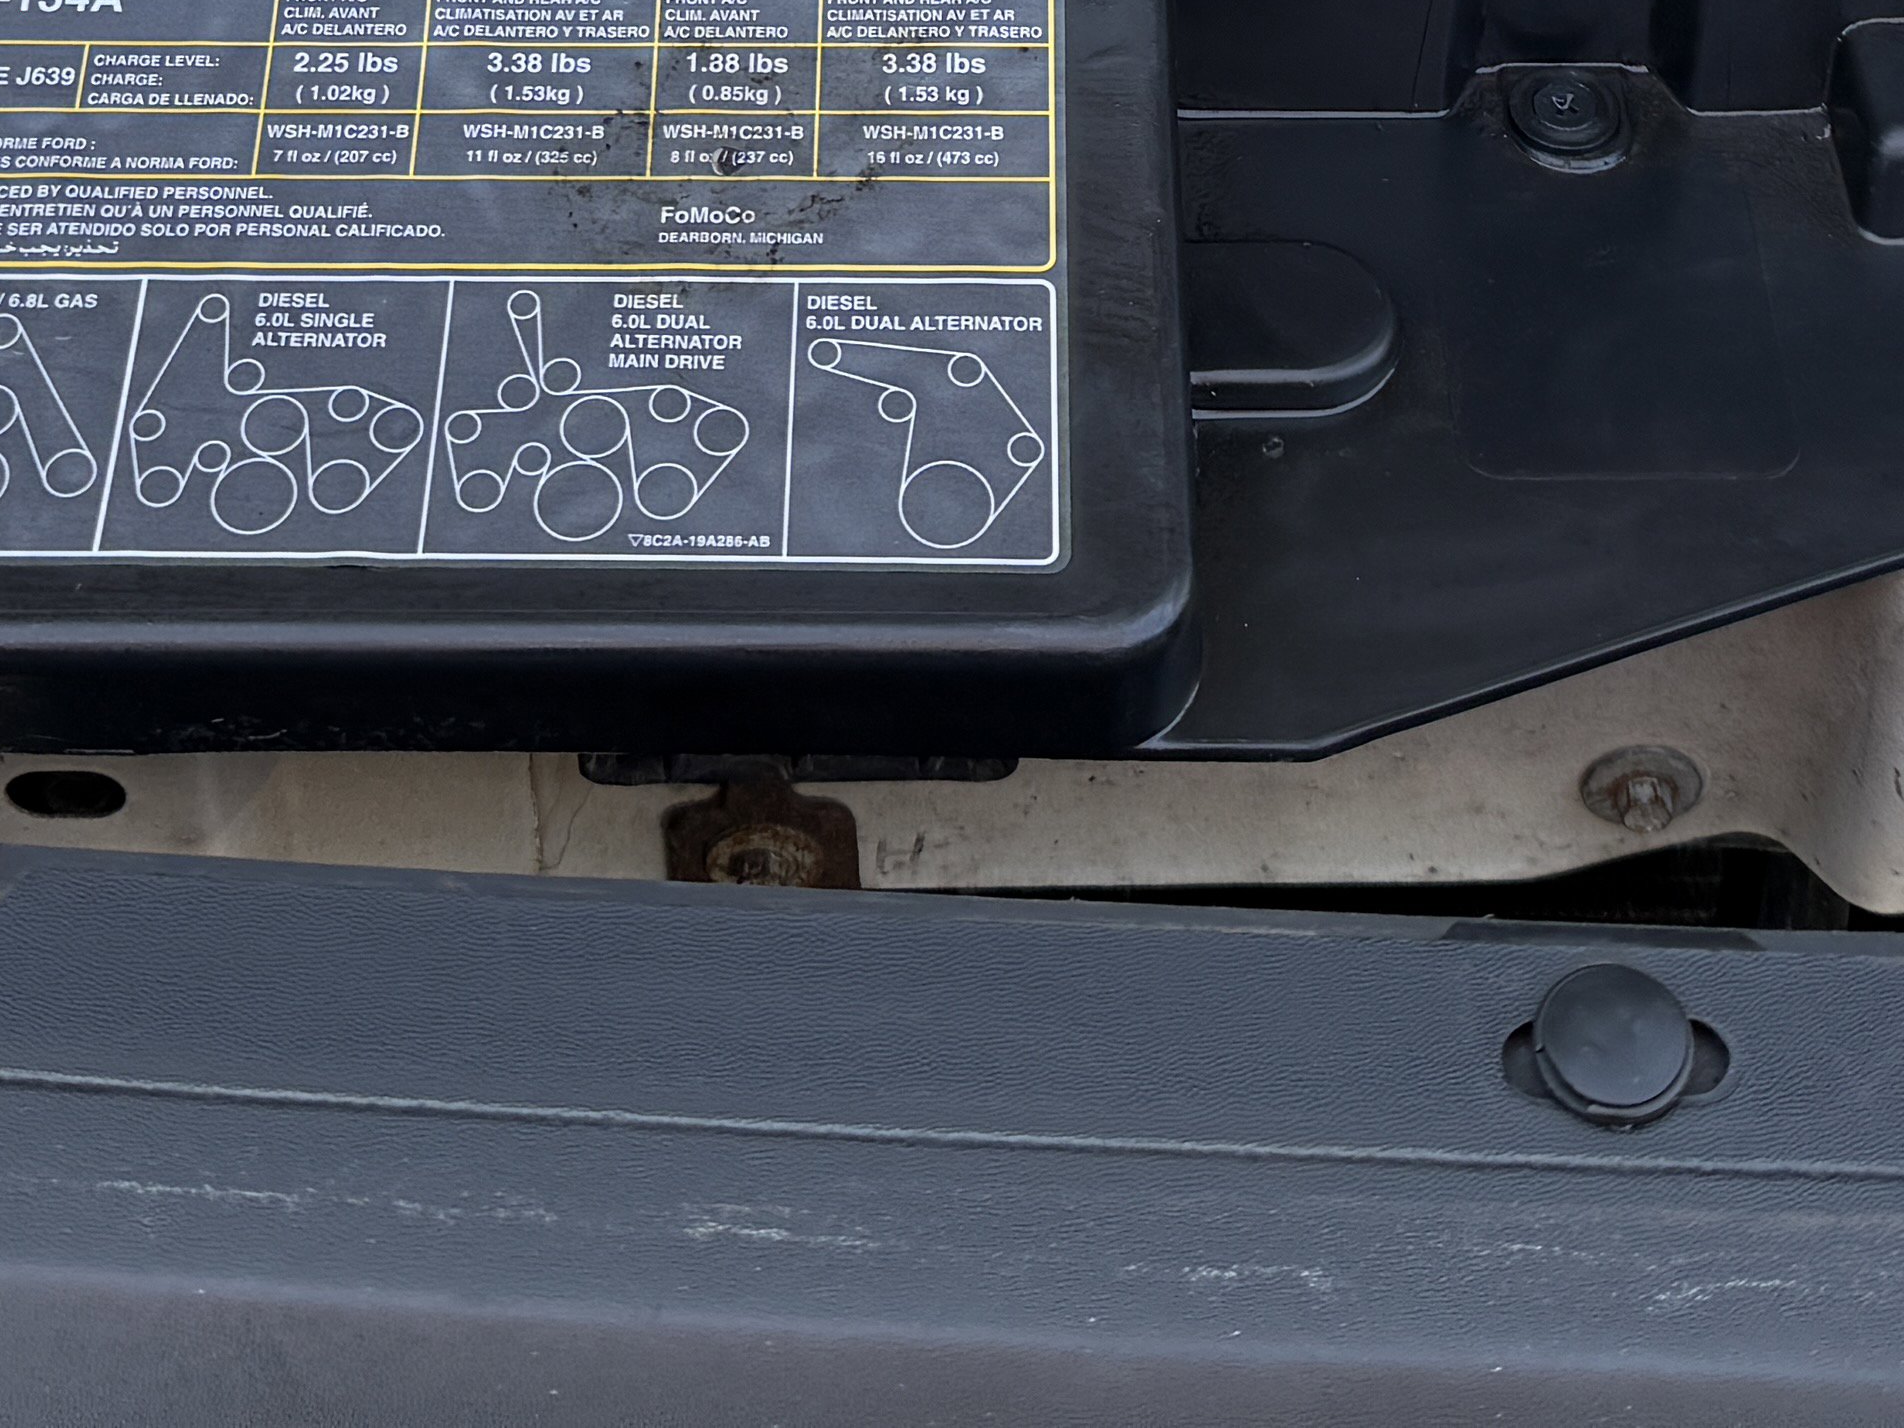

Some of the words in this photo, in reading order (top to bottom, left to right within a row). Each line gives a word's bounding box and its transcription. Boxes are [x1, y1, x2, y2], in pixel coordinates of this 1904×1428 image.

[282, 5, 325, 19] CLIM.
[327, 6, 381, 19] AVANT
[280, 22, 309, 35] A/C
[311, 22, 407, 36] DELANTERO
[92, 53, 162, 67] CHARGE
[164, 54, 220, 67] LEVEL:
[292, 51, 350, 73] 2.25
[357, 51, 398, 73] lbs
[486, 51, 543, 73] 3.38
[550, 52, 591, 74] lbs
[685, 51, 740, 74] 1.88
[748, 52, 789, 74] lbs
[881, 52, 937, 74] 3.38
[945, 51, 986, 74] lbs
[14, 65, 76, 86] J639
[89, 72, 163, 87] CHARGE:
[86, 91, 145, 106] CARGA
[147, 92, 171, 106] DE
[173, 92, 254, 106] LLENADO:
[266, 123, 410, 139] WSH-M1C231-B
[462, 122, 605, 140] WSH-M1C231-B
[662, 123, 804, 140] WSH-M1C231-B
[861, 124, 1005, 141] WSH-M1C231-B
[35, 183, 62, 198] BY
[64, 184, 159, 200] QUALIFIED
[161, 185, 274, 200] PERSONNEL.
[660, 205, 756, 225] FoMoCo
[5, 221, 43, 237] SER
[44, 221, 137, 237] ATENDIDO
[139, 222, 190, 237] SOLO
[193, 222, 232, 237] POR
[234, 222, 332, 237] PERSONAL
[334, 223, 446, 238] CALIFICADO.
[749, 231, 824, 248] MICHIGAN
[7, 292, 49, 309] 6.8L
[52, 292, 98, 309] GAS
[257, 292, 330, 308] DIESEL
[612, 293, 684, 309] DIESEL
[806, 294, 878, 311] DIESEL
[254, 311, 295, 328] 6.0L
[299, 312, 375, 328] SINGLE
[610, 313, 652, 329] 6.0L
[655, 313, 711, 330] DUAL
[805, 314, 846, 331] 6.0L
[850, 314, 906, 331] DUAL
[908, 314, 1043, 332] ALTERNATOR
[250, 330, 387, 348] ALTERNATOR
[608, 332, 743, 350] ALTERNATOR
[607, 352, 659, 369] MAIN
[663, 353, 726, 370] DRIVE
